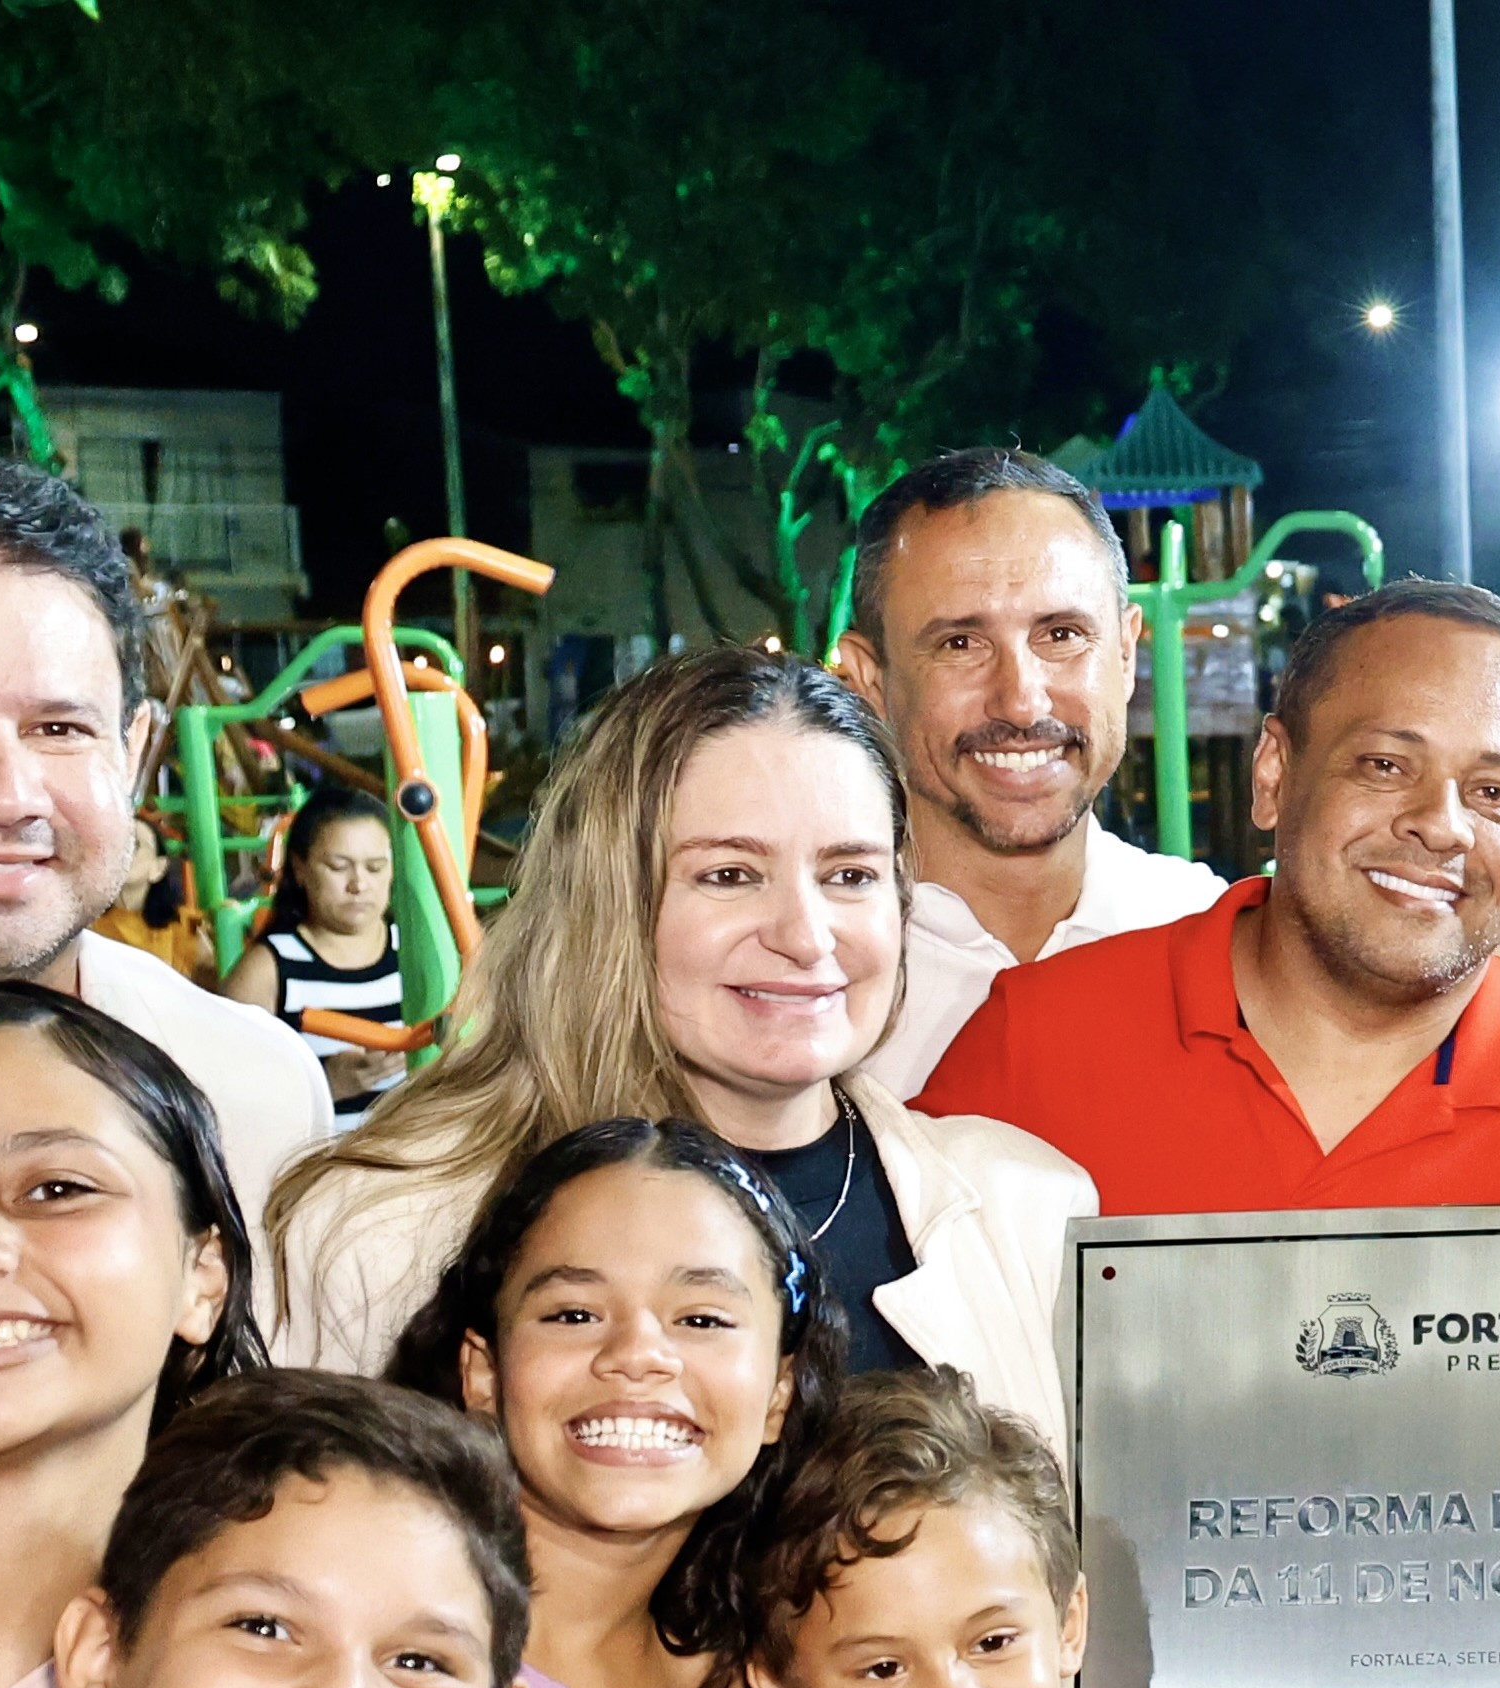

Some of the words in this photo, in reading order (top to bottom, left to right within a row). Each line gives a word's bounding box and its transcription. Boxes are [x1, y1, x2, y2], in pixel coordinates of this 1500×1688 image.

[1188, 1491, 1477, 1540] REFORMA
[1184, 1565, 1264, 1609] DA
[1277, 1563, 1340, 1607] 11
[1356, 1561, 1431, 1605] DE
[1350, 1652, 1451, 1667] FORTALEZA,
